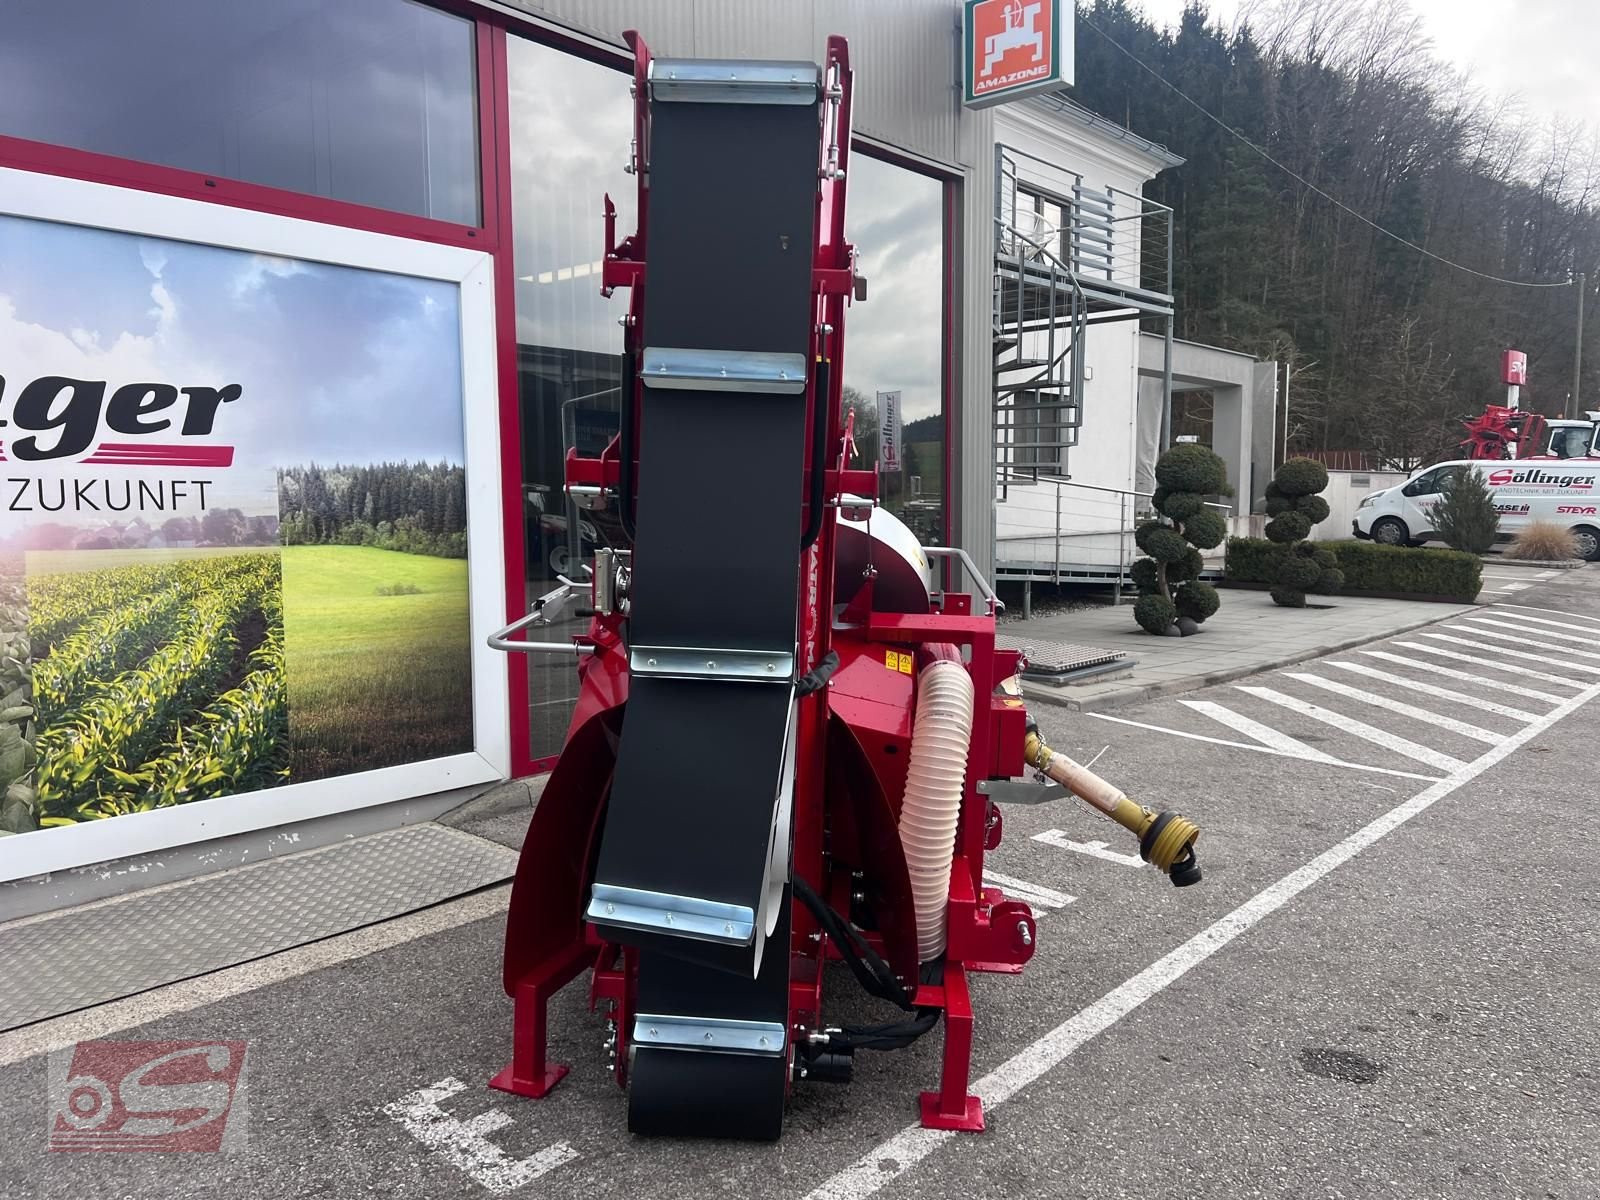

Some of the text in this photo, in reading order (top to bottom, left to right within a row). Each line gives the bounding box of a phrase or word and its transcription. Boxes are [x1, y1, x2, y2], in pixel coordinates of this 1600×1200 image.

[975, 64, 1048, 91] AMAZONE
[0, 374, 243, 461] ger
[1489, 469, 1596, 488] Söllinger
[7, 478, 213, 511] ZUKUNFT
[1491, 503, 1520, 511] CASE
[1556, 505, 1597, 515] STEYR
